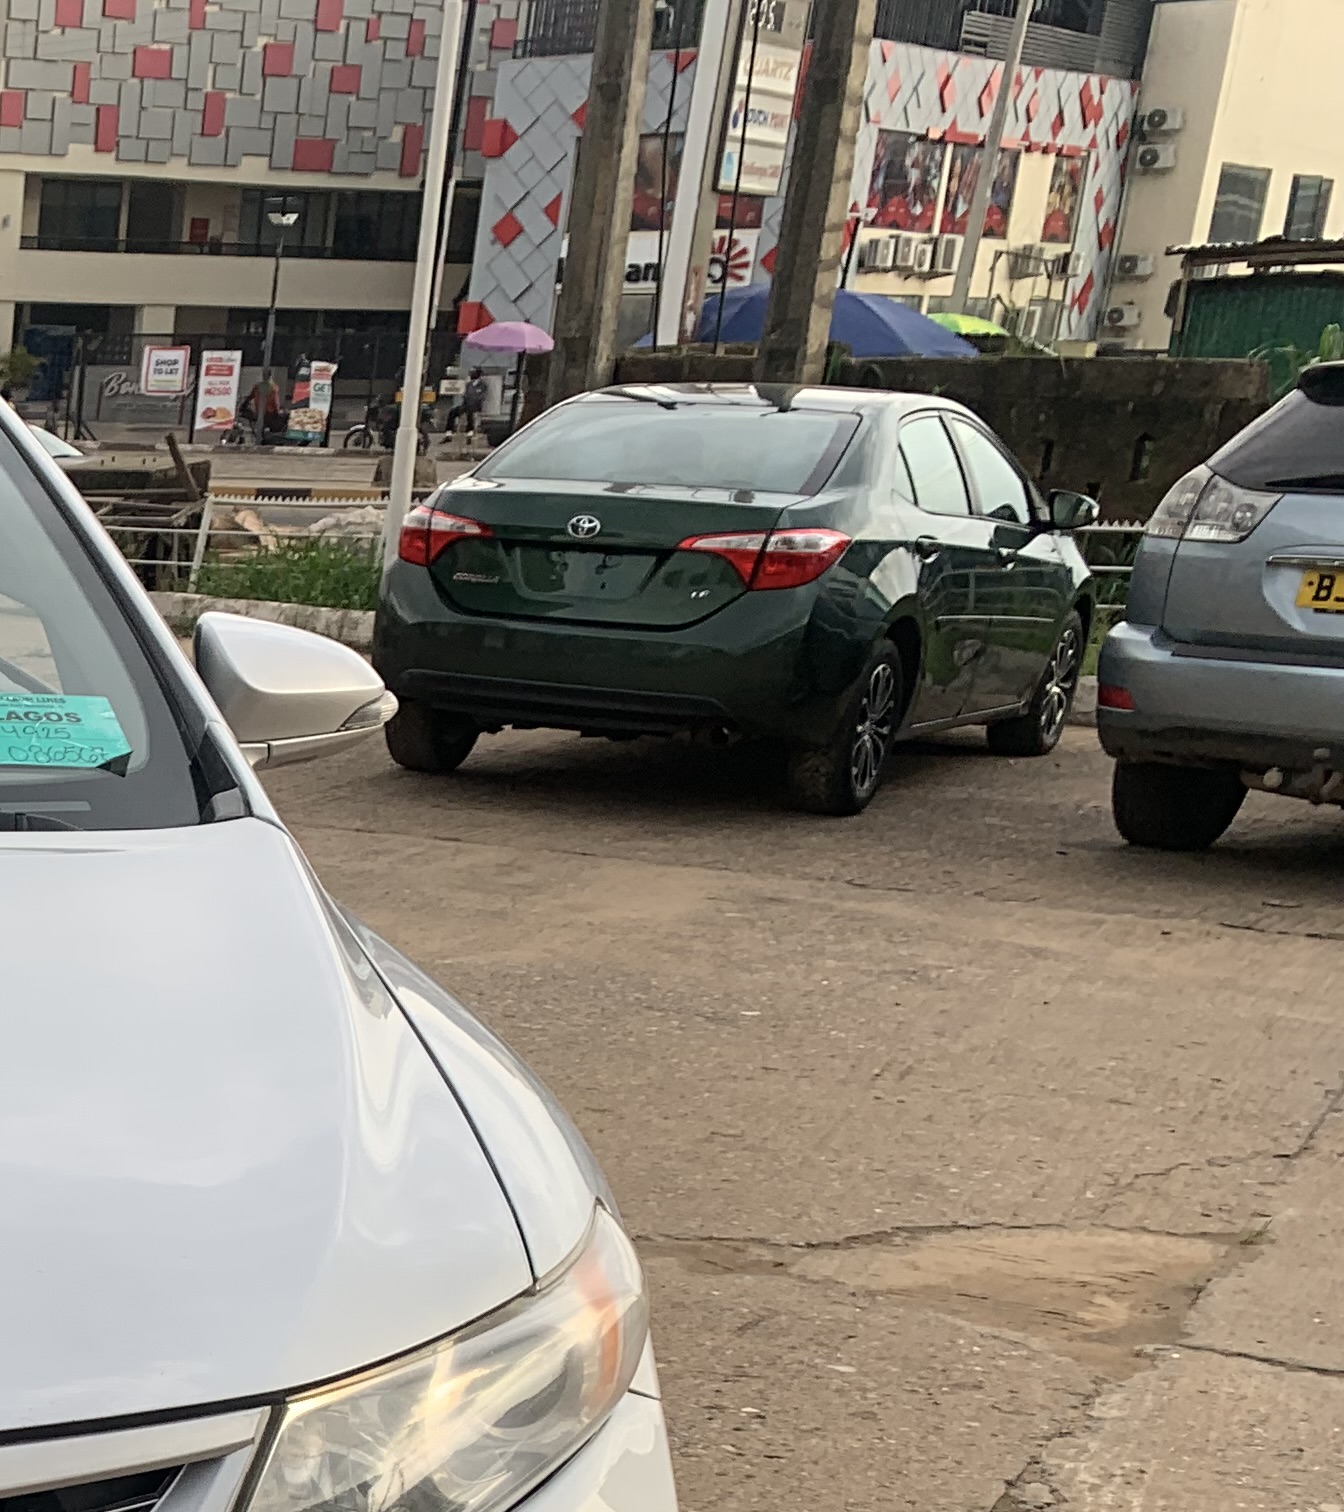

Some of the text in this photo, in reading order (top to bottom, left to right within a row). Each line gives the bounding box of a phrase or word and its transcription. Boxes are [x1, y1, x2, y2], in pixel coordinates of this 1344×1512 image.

[154, 358, 179, 367] SHOP
[153, 367, 179, 375] TO LET
[313, 382, 332, 393] GET
[1312, 573, 1344, 601] B
